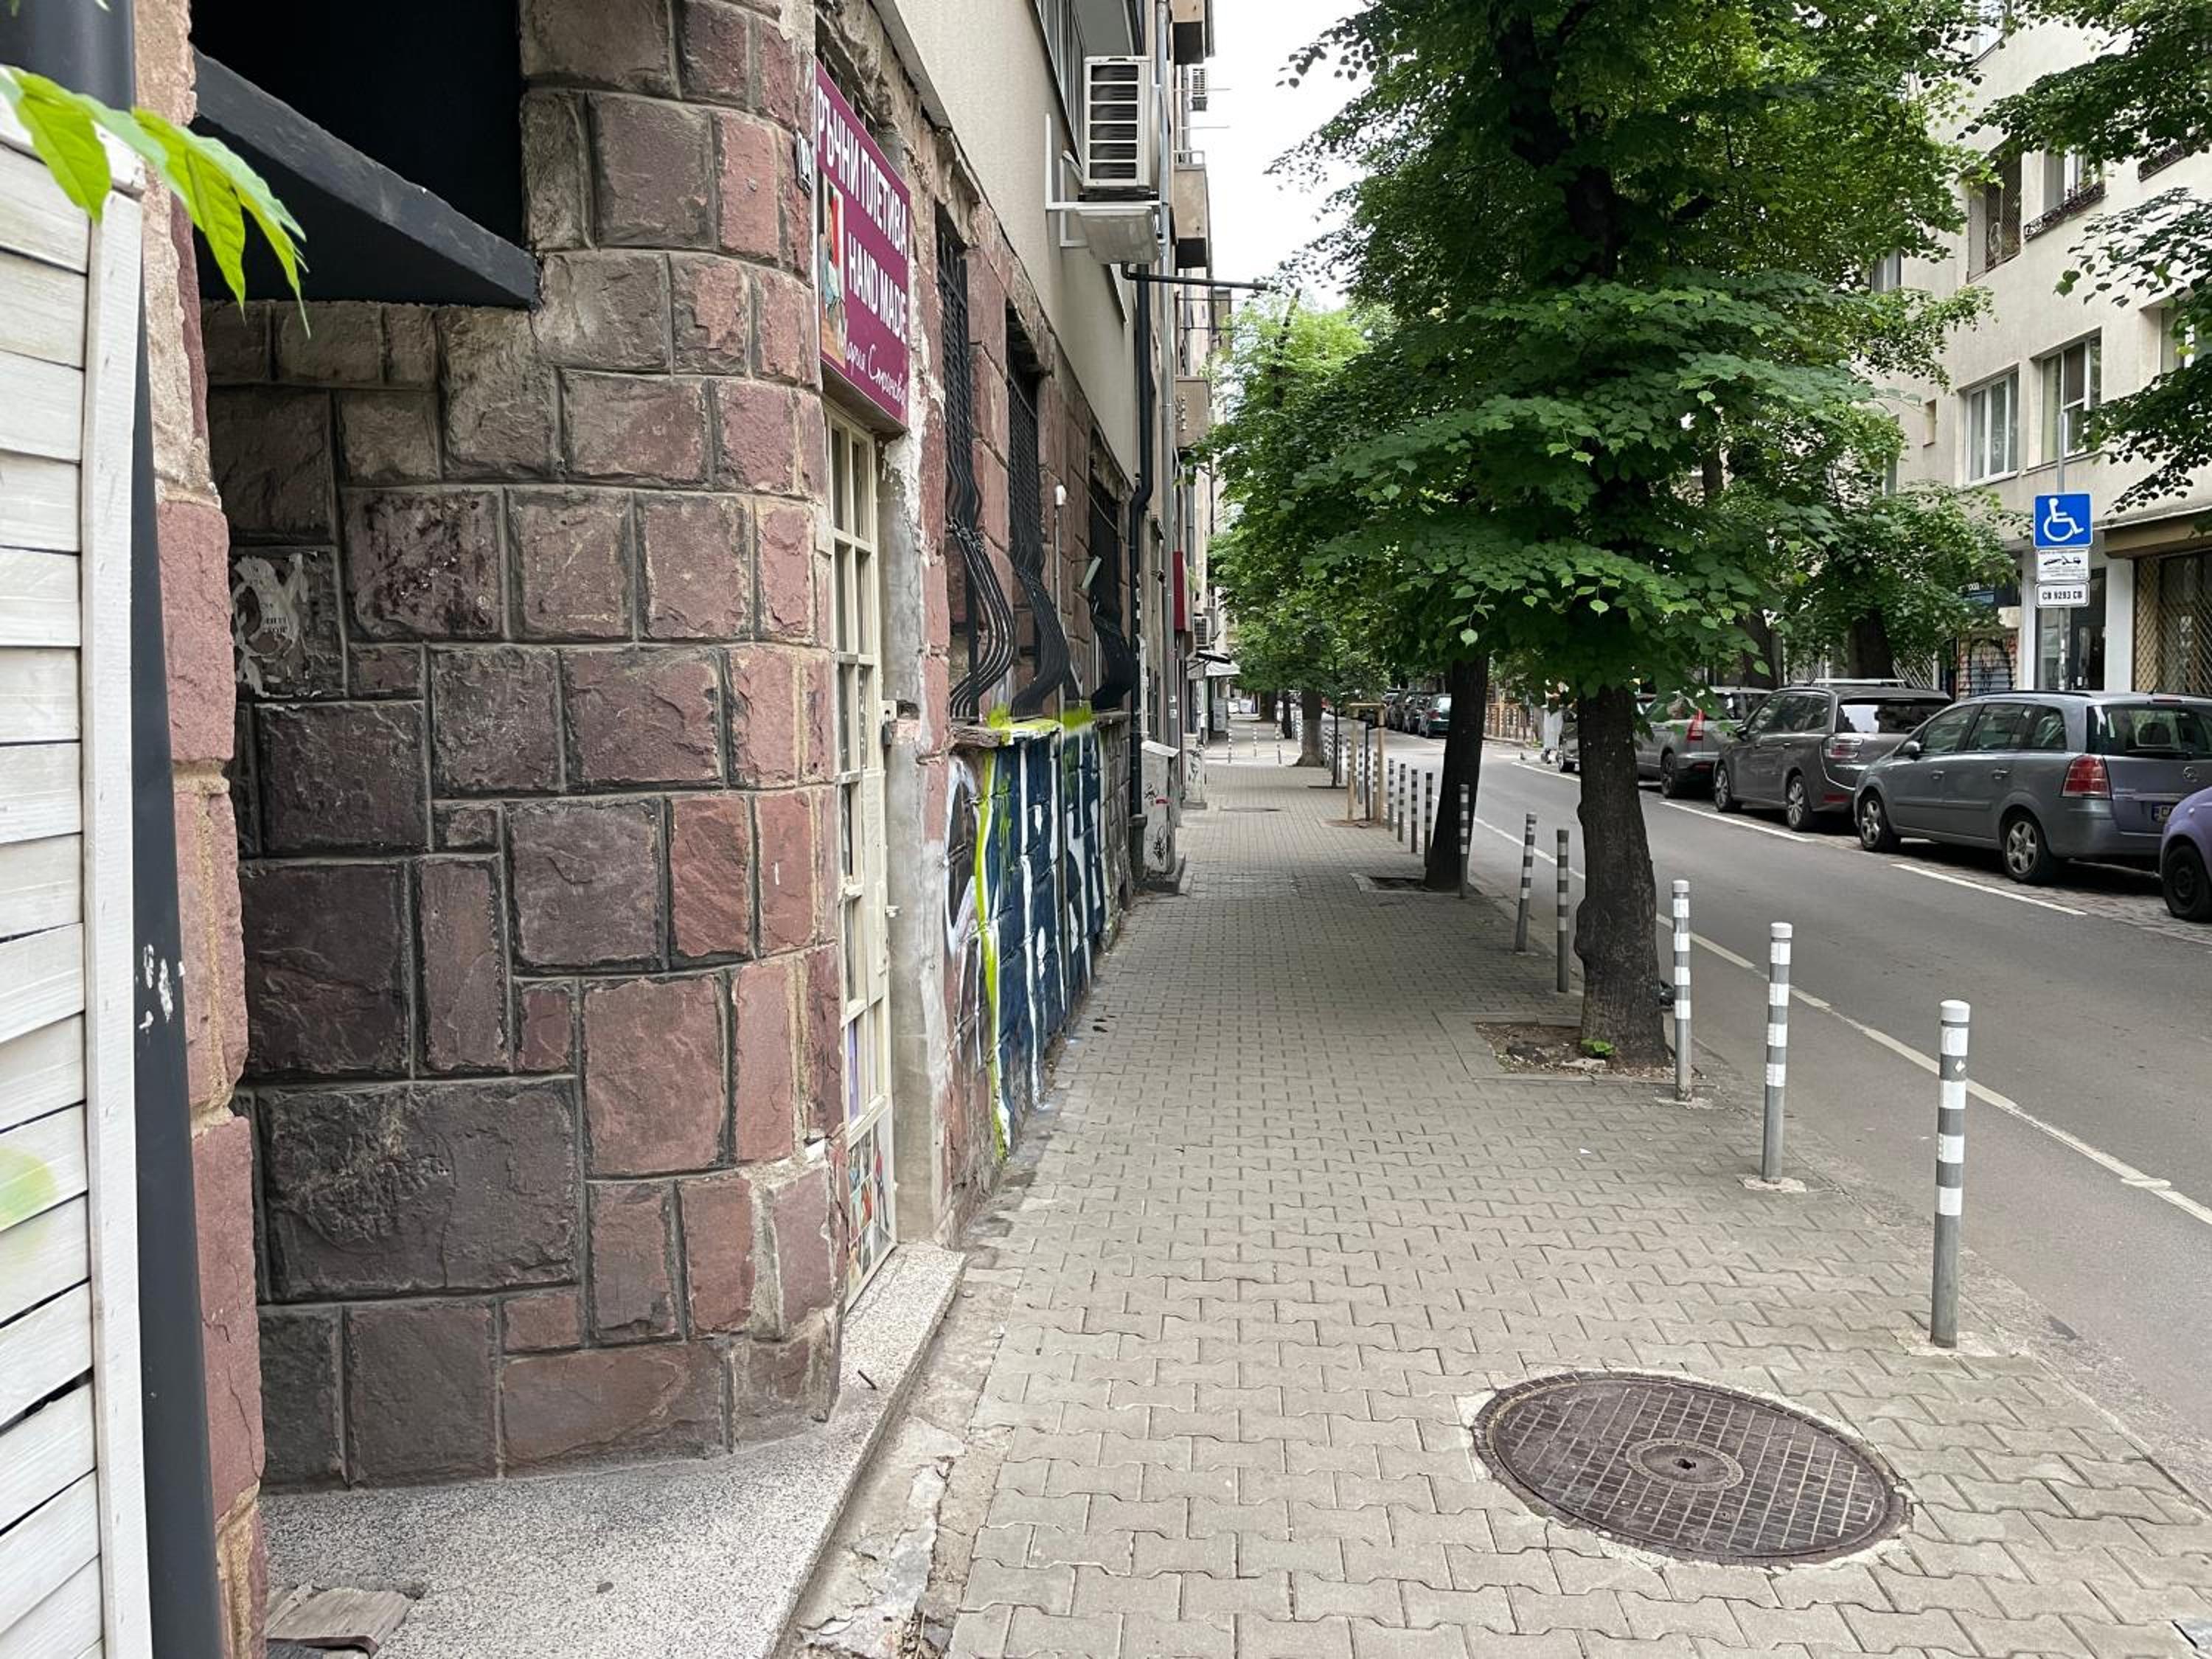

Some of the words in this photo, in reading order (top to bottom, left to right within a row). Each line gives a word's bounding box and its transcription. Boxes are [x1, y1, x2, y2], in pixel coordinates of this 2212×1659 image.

[818, 84, 859, 201] РЪЧНИ
[860, 145, 908, 261] ПЛЕТИВА
[848, 231, 878, 315] HAND
[880, 268, 906, 345] MADE
